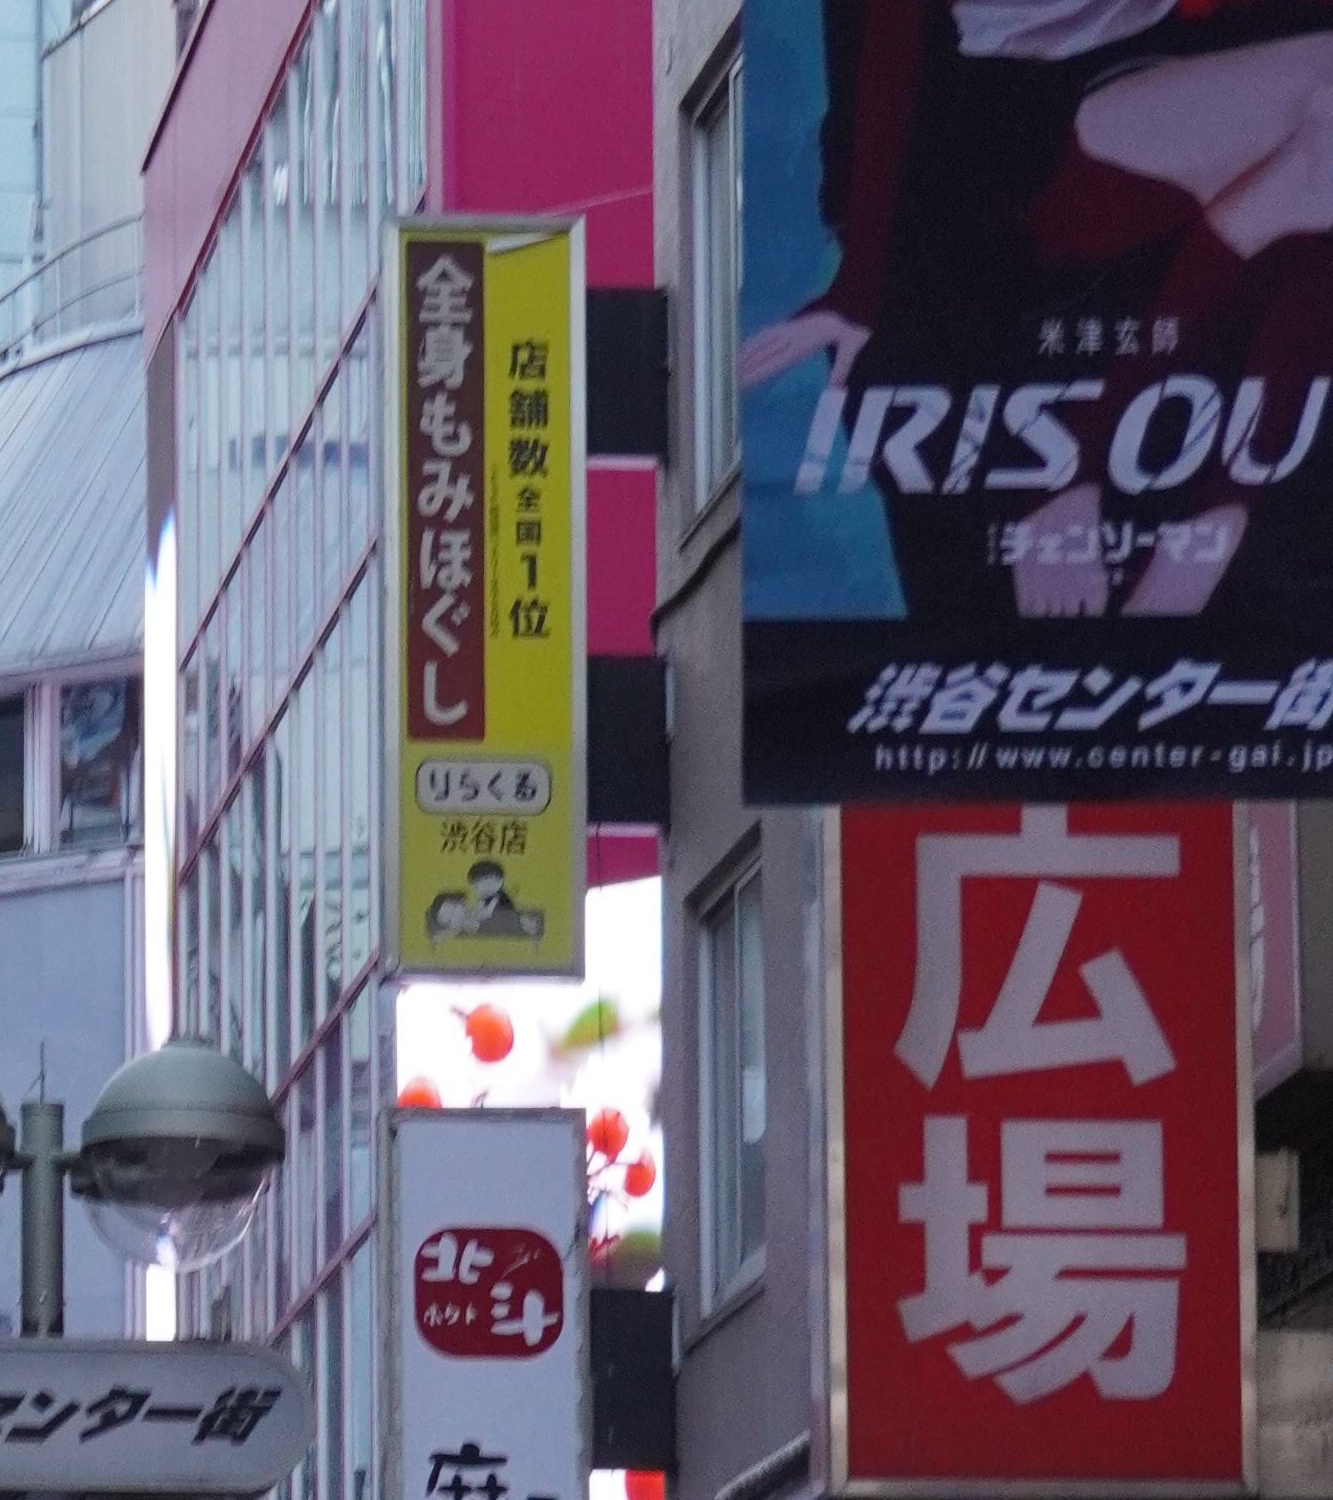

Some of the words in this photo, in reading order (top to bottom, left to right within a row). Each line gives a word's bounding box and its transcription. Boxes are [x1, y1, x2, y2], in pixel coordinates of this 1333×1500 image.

[416, 254, 474, 727] 全身もみほぐし
[508, 338, 552, 641] 店舗数全国1位
[794, 374, 1107, 496] IRIS
[999, 520, 1229, 566] チェンソーマン
[440, 820, 528, 855] 渋谷店
[893, 803, 1188, 1409] 広場
[421, 1233, 560, 1347] 北斗
